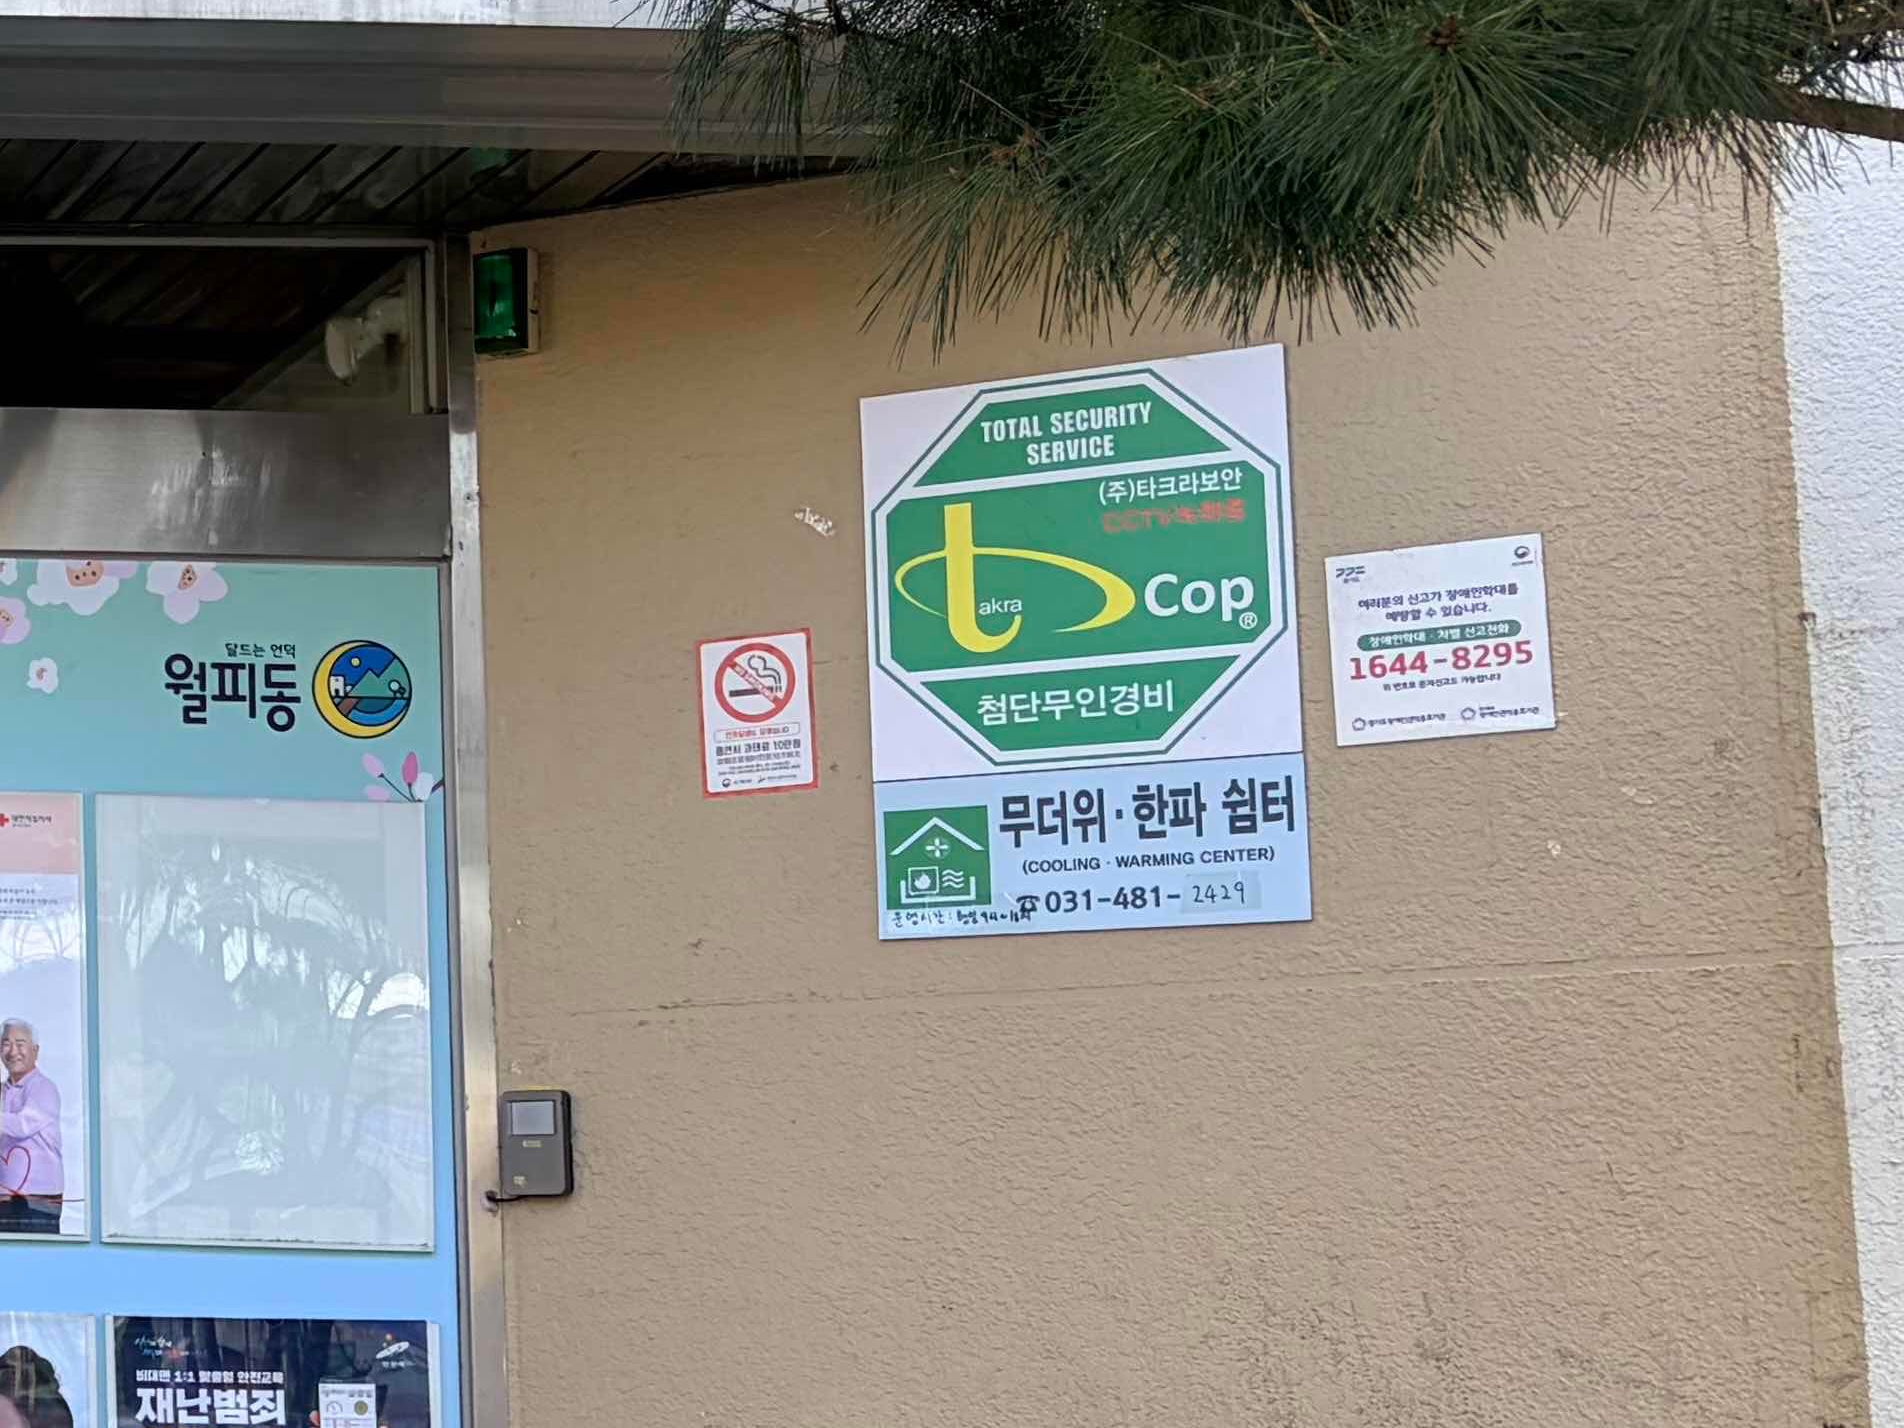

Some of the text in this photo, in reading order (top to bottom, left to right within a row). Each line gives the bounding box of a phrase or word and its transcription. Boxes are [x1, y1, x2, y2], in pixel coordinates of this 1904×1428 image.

[980, 402, 1152, 443] TOTAL SECURITY
[1026, 435, 1116, 466] SERVICE
[1098, 467, 1243, 506] (주)타크라보안
[1144, 573, 1255, 622] Cop
[1358, 594, 1404, 611] 여러분의
[1407, 589, 1442, 606] 신고가
[1425, 606, 1438, 619] 수
[1441, 601, 1492, 617] 있습니다.
[270, 643, 297, 659] 언덕
[1349, 639, 1534, 681] 1644-8295
[164, 653, 302, 733] 월피동
[977, 678, 1174, 727] 첨단무인경비
[1221, 775, 1295, 836] 쉼터
[1022, 845, 1276, 876] (COOLING WARMING CENTER)
[135, 1387, 287, 1426] 재난범죄
